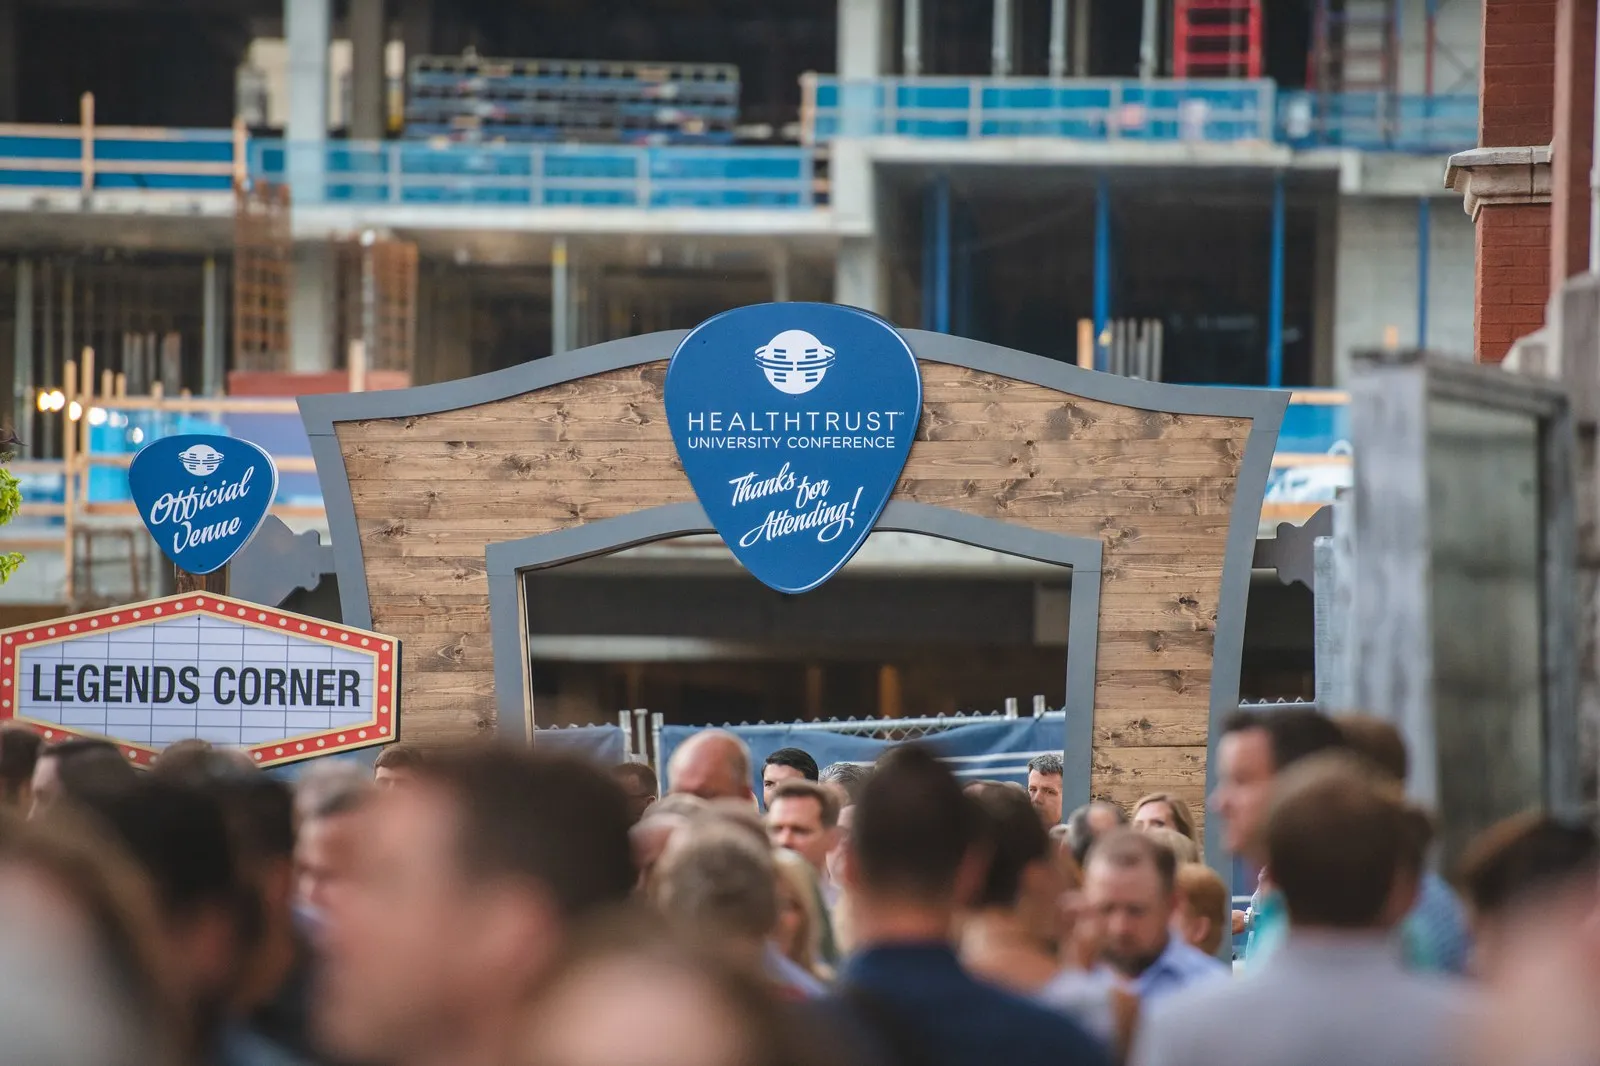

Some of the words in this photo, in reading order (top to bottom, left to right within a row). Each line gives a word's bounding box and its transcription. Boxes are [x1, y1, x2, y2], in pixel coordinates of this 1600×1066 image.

[687, 436, 782, 449] UNIVERSITY
[787, 436, 895, 449] CONFERENCE
[150, 465, 255, 525] Official
[728, 461, 796, 507] Thanks
[797, 475, 831, 508] for
[173, 516, 242, 554] Venue
[739, 486, 864, 547] Attending!
[32, 664, 200, 704] LEGENDS
[213, 666, 361, 707] CORNER
